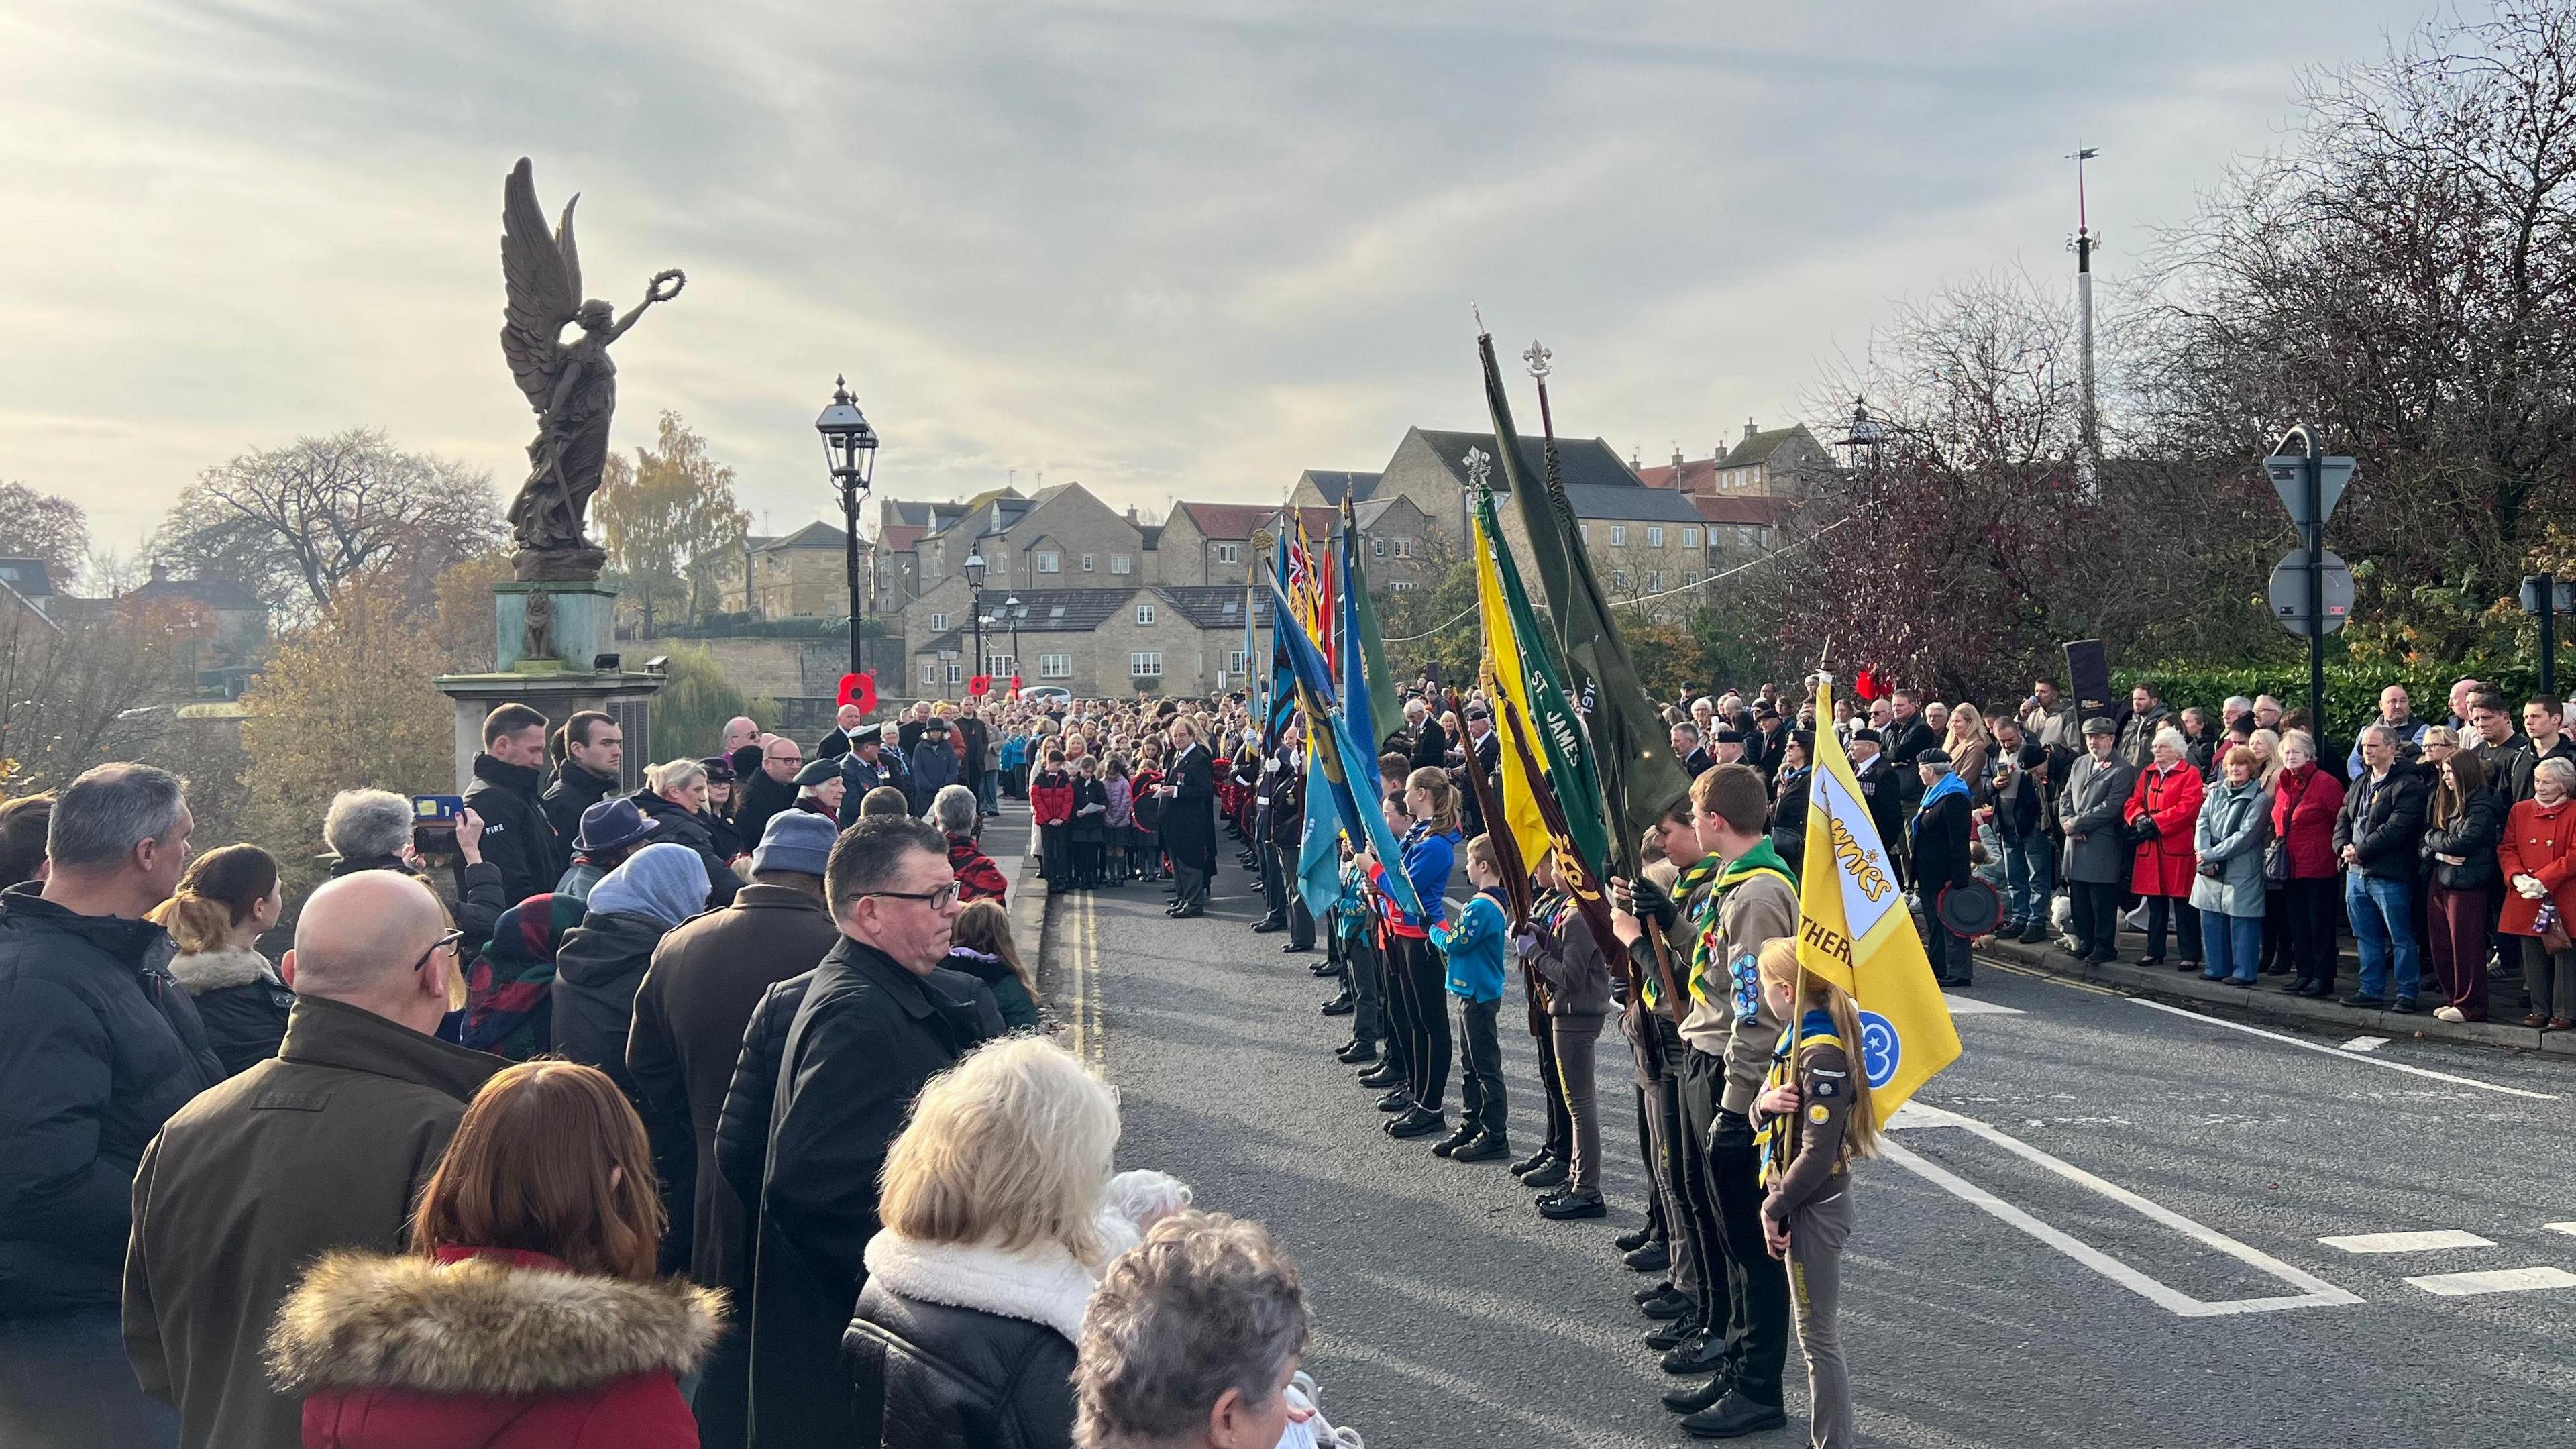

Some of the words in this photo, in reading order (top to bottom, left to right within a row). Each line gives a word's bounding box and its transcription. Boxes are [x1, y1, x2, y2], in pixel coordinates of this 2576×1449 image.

[1531, 670, 1548, 700] ST.
[1547, 711, 1580, 767] JAMES
[486, 824, 504, 835] FIRE
[1829, 816, 1892, 902] wnies
[1801, 914, 1853, 969] THER
